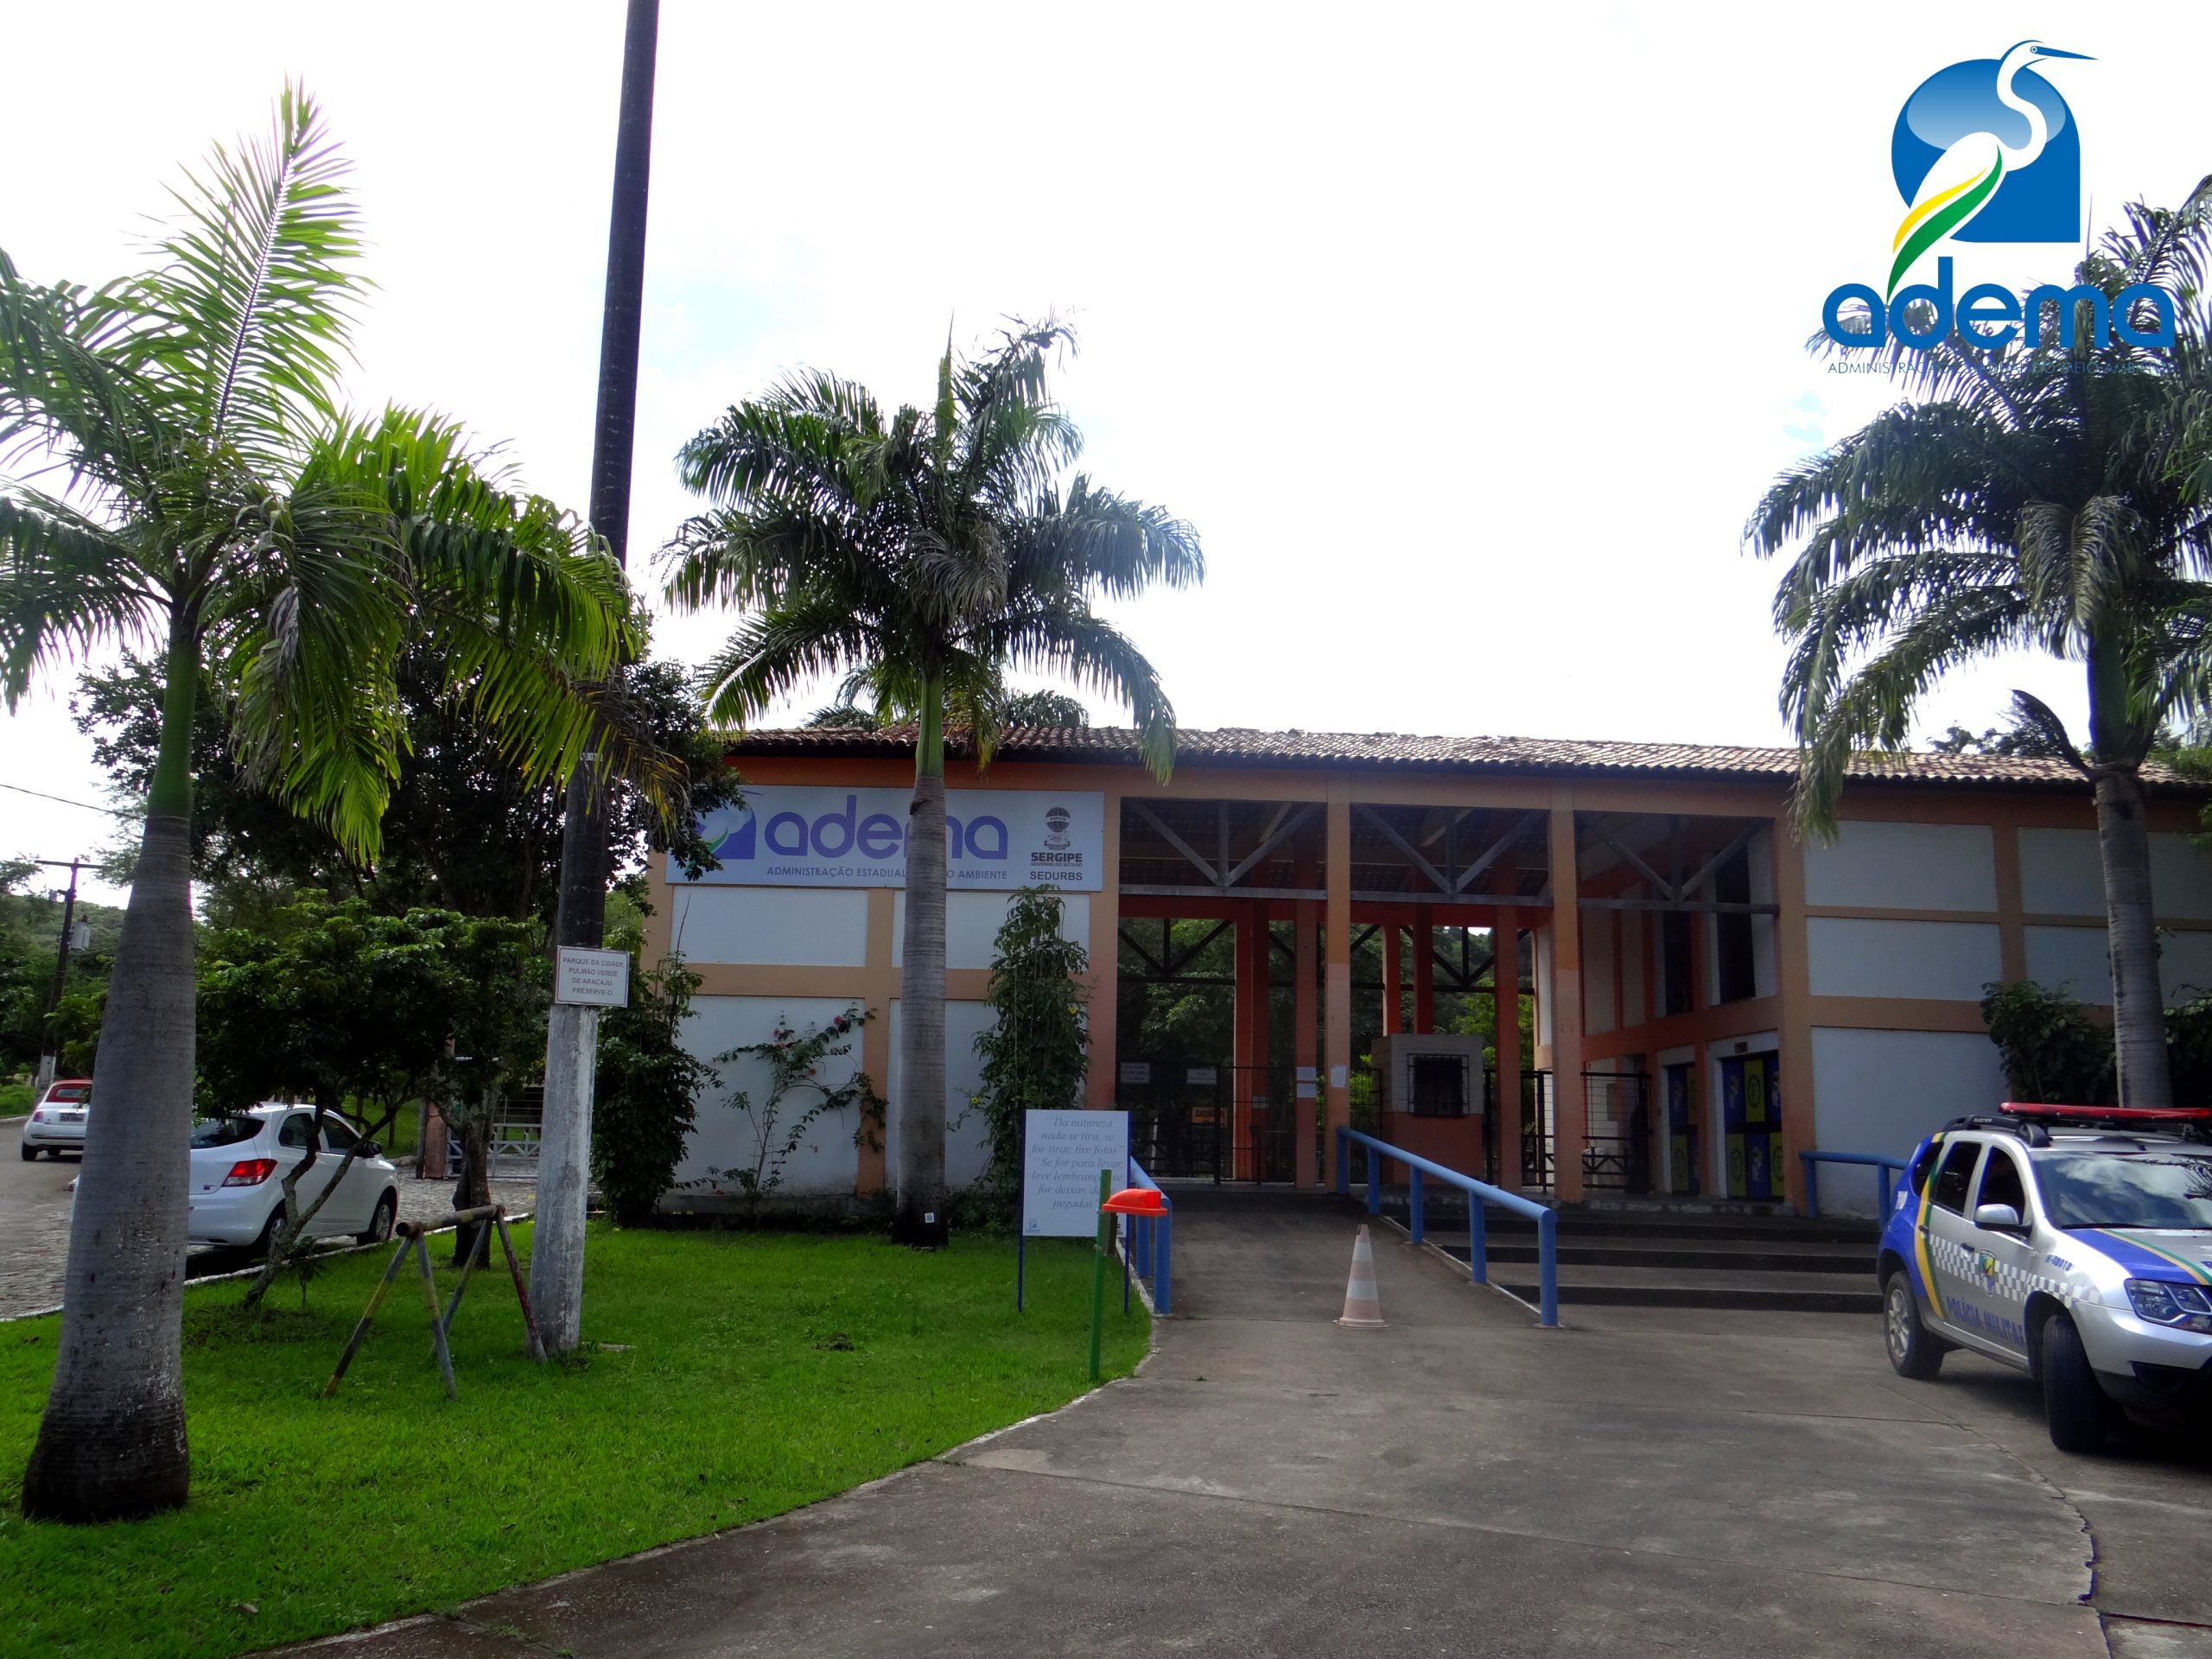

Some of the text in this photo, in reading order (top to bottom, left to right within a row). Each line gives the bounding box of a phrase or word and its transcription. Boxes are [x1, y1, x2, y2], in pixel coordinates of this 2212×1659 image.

[1031, 852, 1083, 862] SERGIPE
[767, 867, 906, 879] ADMINISTRAÇÃO ESTADUAL
[958, 870, 1007, 880] AMBIENTE
[1029, 871, 1083, 881] SEDURBS
[563, 957, 589, 966] PARQUE
[569, 967, 596, 976] PULMÃO
[572, 987, 613, 996] PRESERVE-O
[1071, 1119, 1113, 1128] natureza
[1041, 1130, 1066, 1141] nada
[1030, 1144, 1046, 1155] for
[1075, 1144, 1091, 1154] tire
[1053, 1158, 1070, 1169] for
[1071, 1161, 1095, 1170] para
[1031, 1170, 1052, 1180] leve
[1037, 1185, 1053, 1196] for
